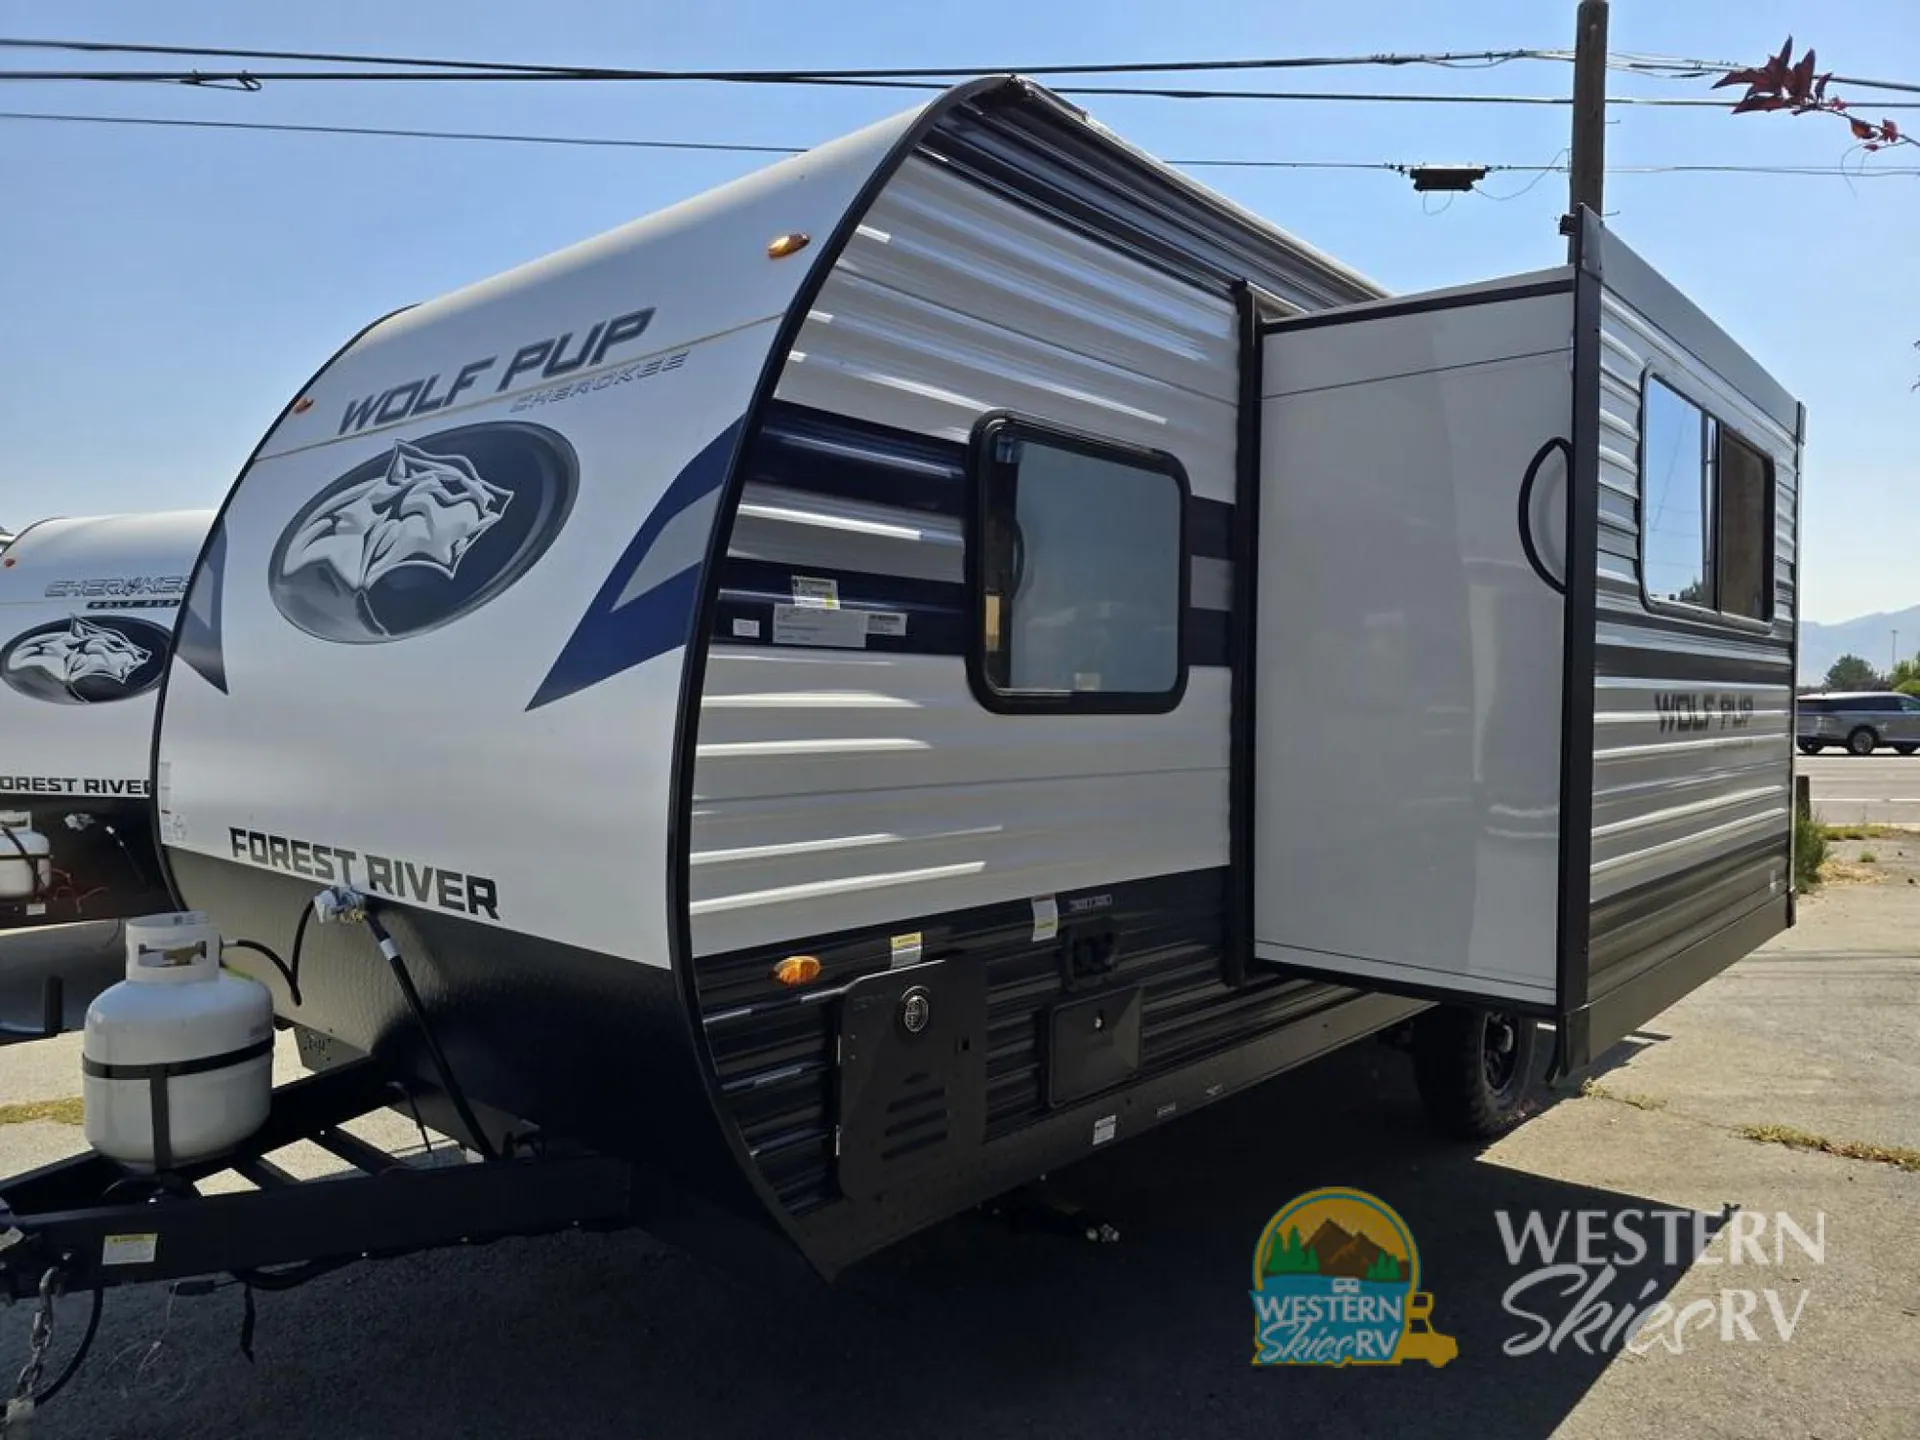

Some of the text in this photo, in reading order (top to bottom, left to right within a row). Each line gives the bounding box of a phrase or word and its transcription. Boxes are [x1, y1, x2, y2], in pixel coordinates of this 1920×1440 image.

[338, 306, 657, 436] WOLF PUP
[509, 349, 691, 414] CHEROKEE
[1654, 692, 1754, 734] WOLF PUP
[0, 776, 78, 792] OREST
[228, 826, 500, 921] FOREST RIVER
